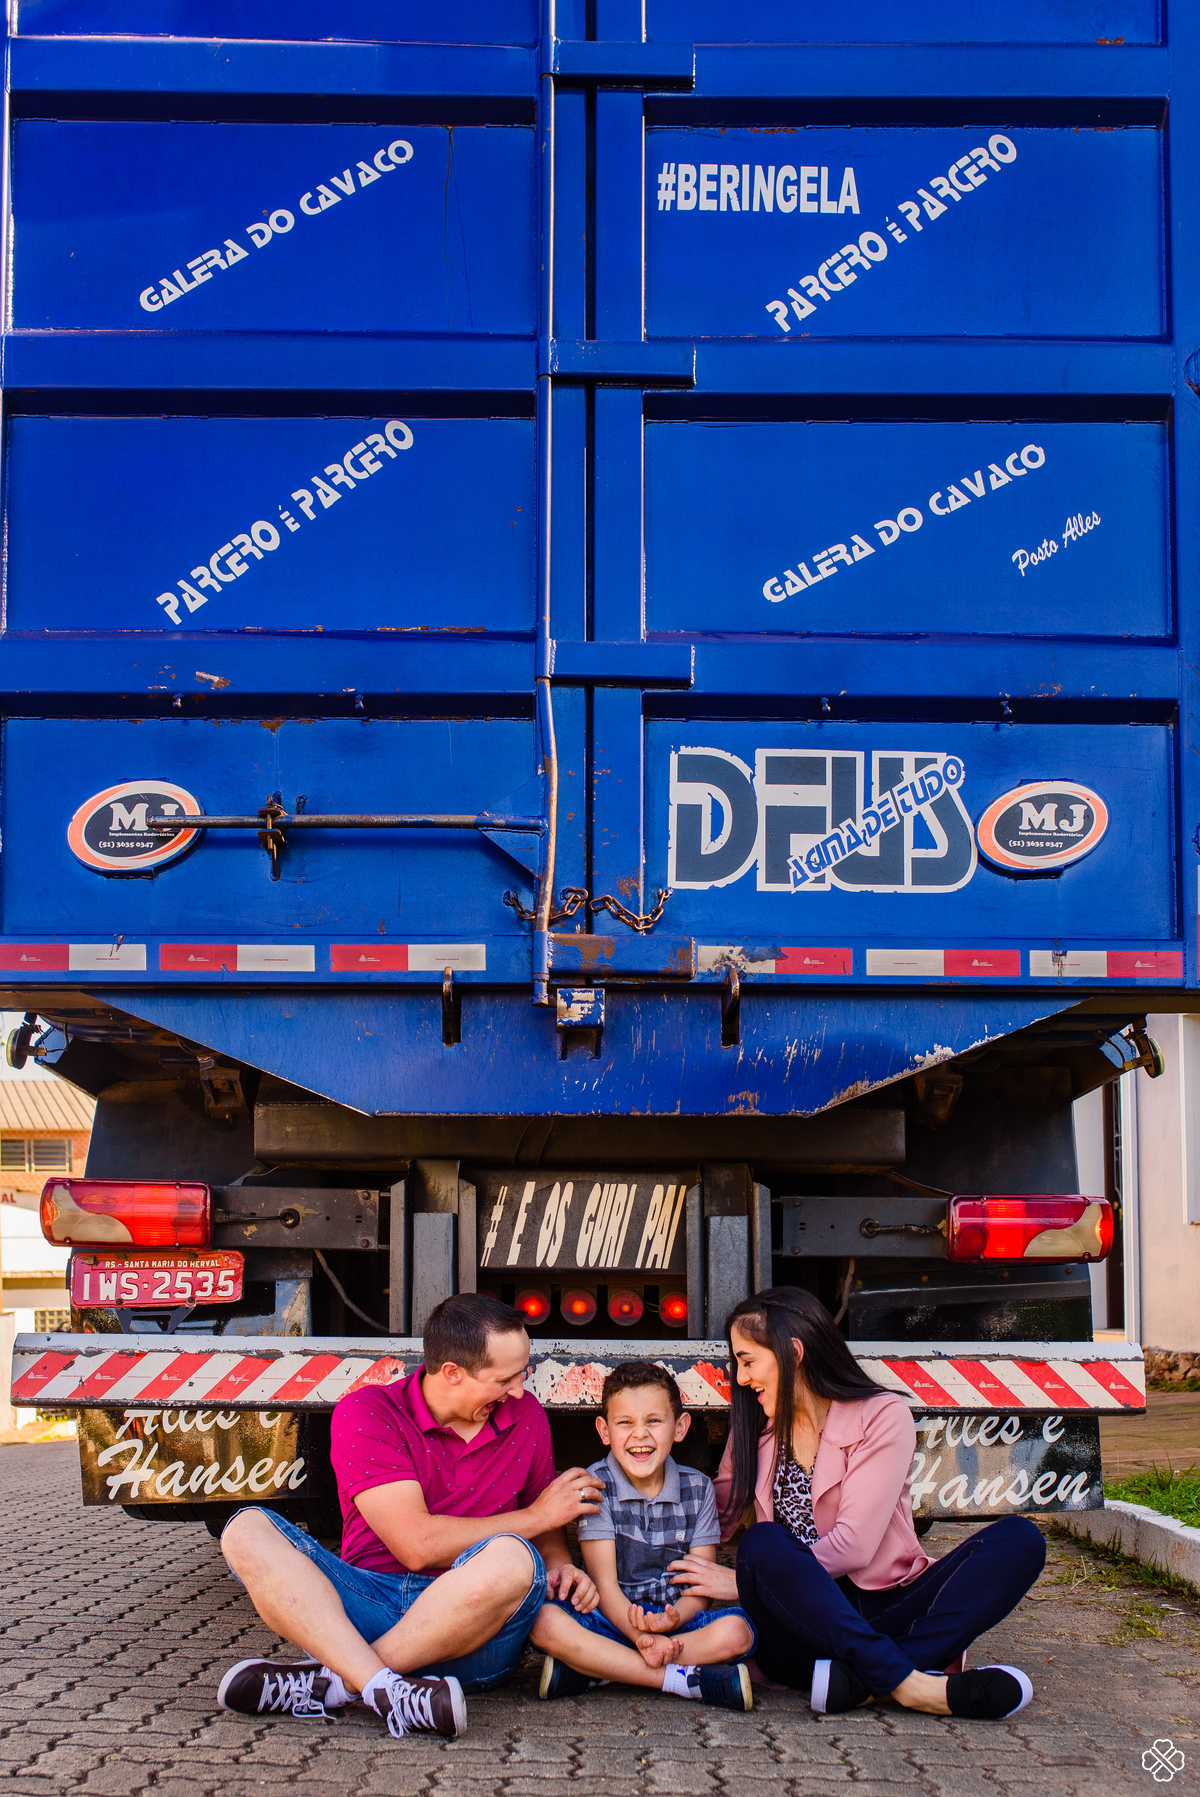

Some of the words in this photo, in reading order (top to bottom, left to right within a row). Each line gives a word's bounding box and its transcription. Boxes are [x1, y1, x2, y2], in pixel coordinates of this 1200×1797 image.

[657, 162, 860, 214] #BERINGELA
[140, 239, 248, 312] GALERA
[246, 208, 295, 249] DO
[300, 140, 414, 215] CAVACO
[766, 231, 888, 332] PARCERO
[898, 134, 1017, 231] PARCERO
[156, 520, 280, 625] PARCERO
[291, 420, 414, 520] PARCERO
[763, 534, 875, 602] GALERA
[874, 507, 924, 546] DO
[929, 444, 1045, 515] CAVACO
[1011, 539, 1059, 577] Posto
[1062, 511, 1101, 548] Alles
[98, 840, 115, 848] (51)
[668, 745, 978, 893] DEUS
[792, 823, 864, 889] ACIMA
[862, 797, 897, 838] DE
[897, 758, 962, 814] TUDO
[1008, 839, 1025, 848] (51)
[1026, 840, 1044, 848] 3635
[1045, 841, 1063, 849] 0347
[1018, 802, 1088, 832] MJ
[480, 1186, 508, 1267] #
[506, 1181, 536, 1266] E
[535, 1181, 573, 1267] OS
[575, 1182, 637, 1267] GURI
[634, 1184, 687, 1269] PAI
[124, 1260, 149, 1268] SANTA
[151, 1260, 175, 1268] MARIA
[177, 1260, 188, 1268] DO
[189, 1259, 221, 1268] HERVAL
[1042, 1416, 1065, 1443] e
[98, 1439, 307, 1500] Hansen
[910, 1452, 1090, 1511] Hansen
